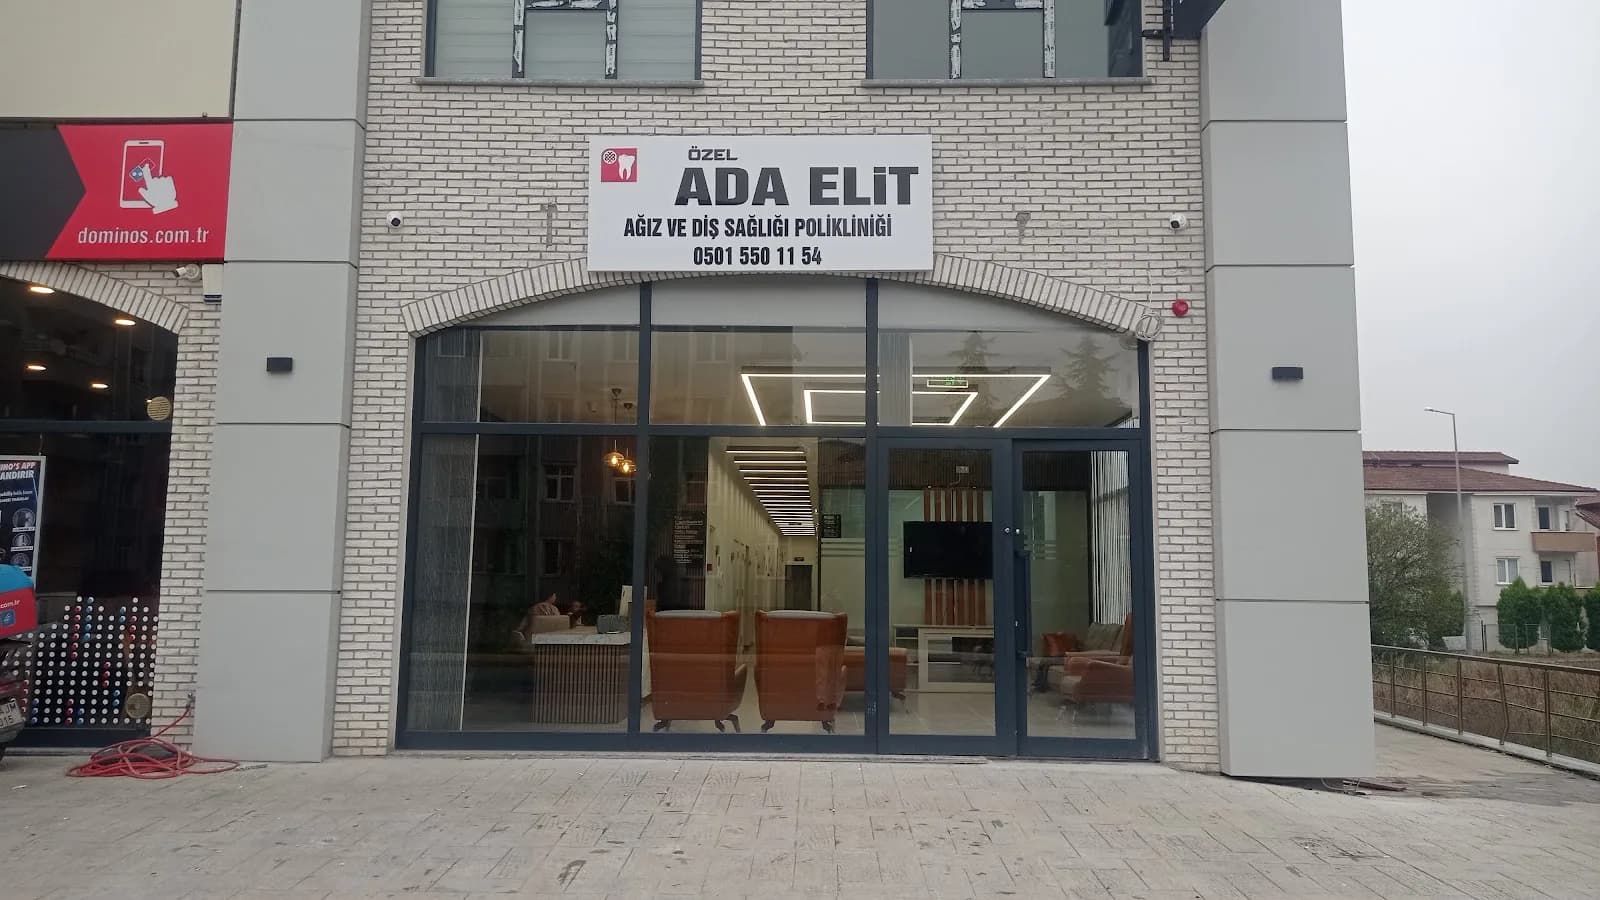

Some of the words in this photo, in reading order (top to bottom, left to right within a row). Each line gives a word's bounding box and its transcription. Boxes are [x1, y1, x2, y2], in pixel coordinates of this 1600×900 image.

[688, 146, 738, 160] ÖZEL
[674, 168, 789, 205] ADA
[78, 227, 209, 243] dominos.com.tr
[624, 214, 662, 236] AĞIZ
[667, 219, 686, 237] VE
[692, 215, 719, 239] DİŞ
[725, 214, 788, 237] SAĞLIĞI
[795, 214, 891, 236] POLİKLİNİĞİ
[694, 247, 732, 265] 0501
[740, 247, 770, 265] 550
[777, 247, 794, 265] 11
[802, 247, 821, 265] 54
